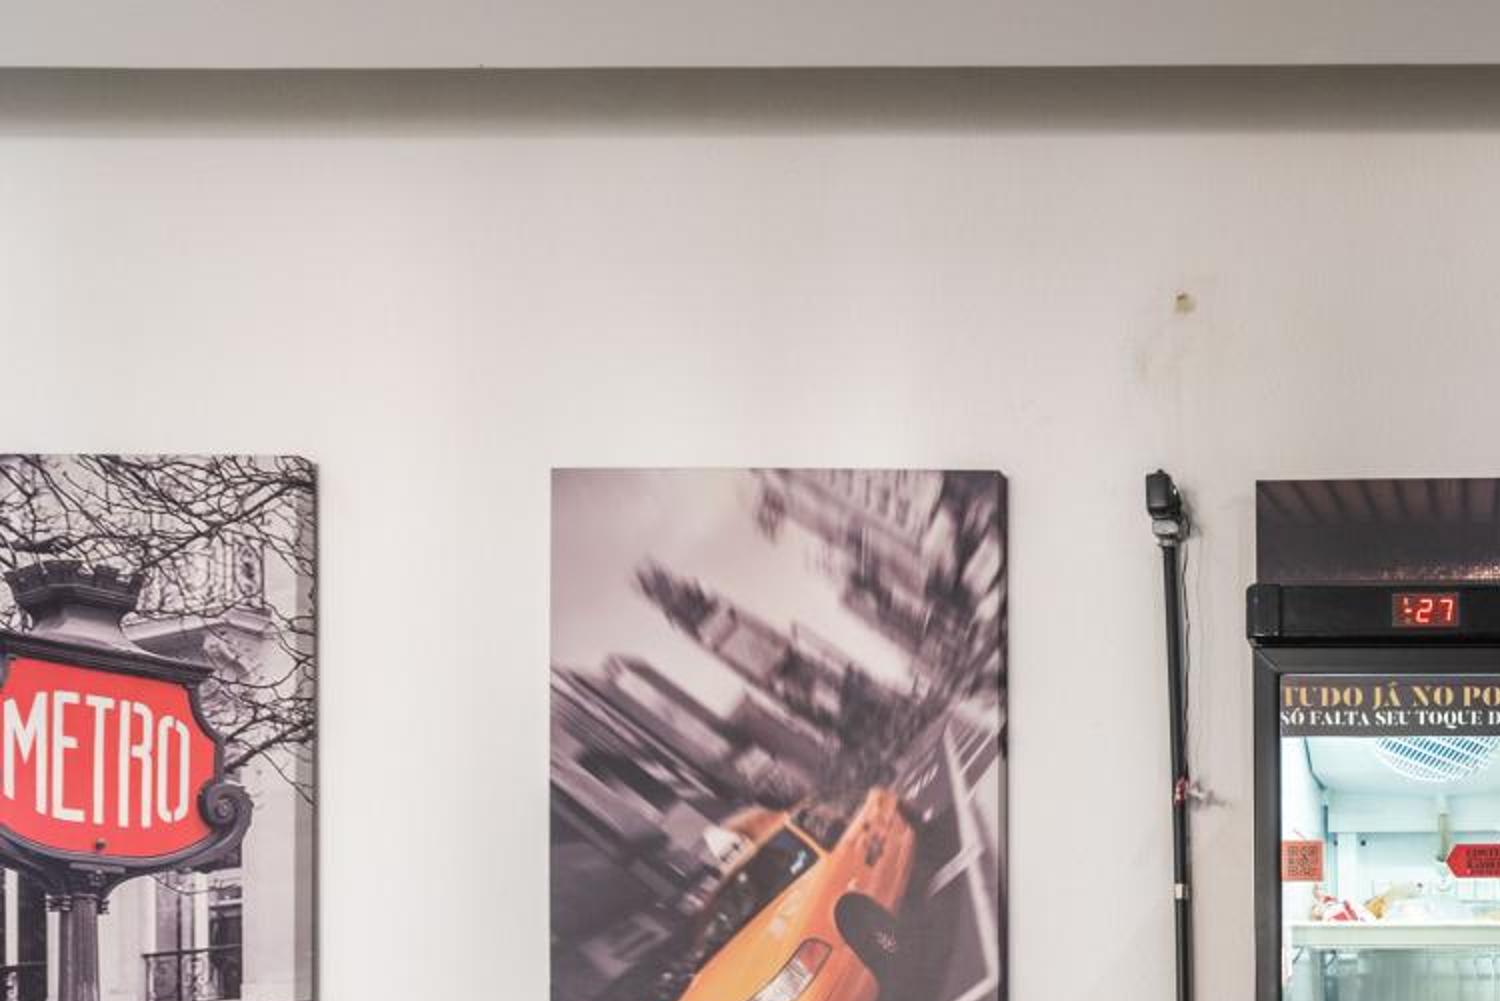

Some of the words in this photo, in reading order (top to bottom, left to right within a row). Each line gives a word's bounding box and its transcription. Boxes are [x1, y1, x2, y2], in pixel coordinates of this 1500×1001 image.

[1283, 685, 1363, 707] TUDO
[1372, 681, 1401, 710] JÁ
[1412, 685, 1455, 707] NO
[1280, 707, 1305, 726] SÓ
[1310, 709, 1370, 726] FALTA
[1374, 709, 1409, 726] SEU
[1413, 708, 1483, 729] TOQUE
[2, 688, 191, 830] METRO
